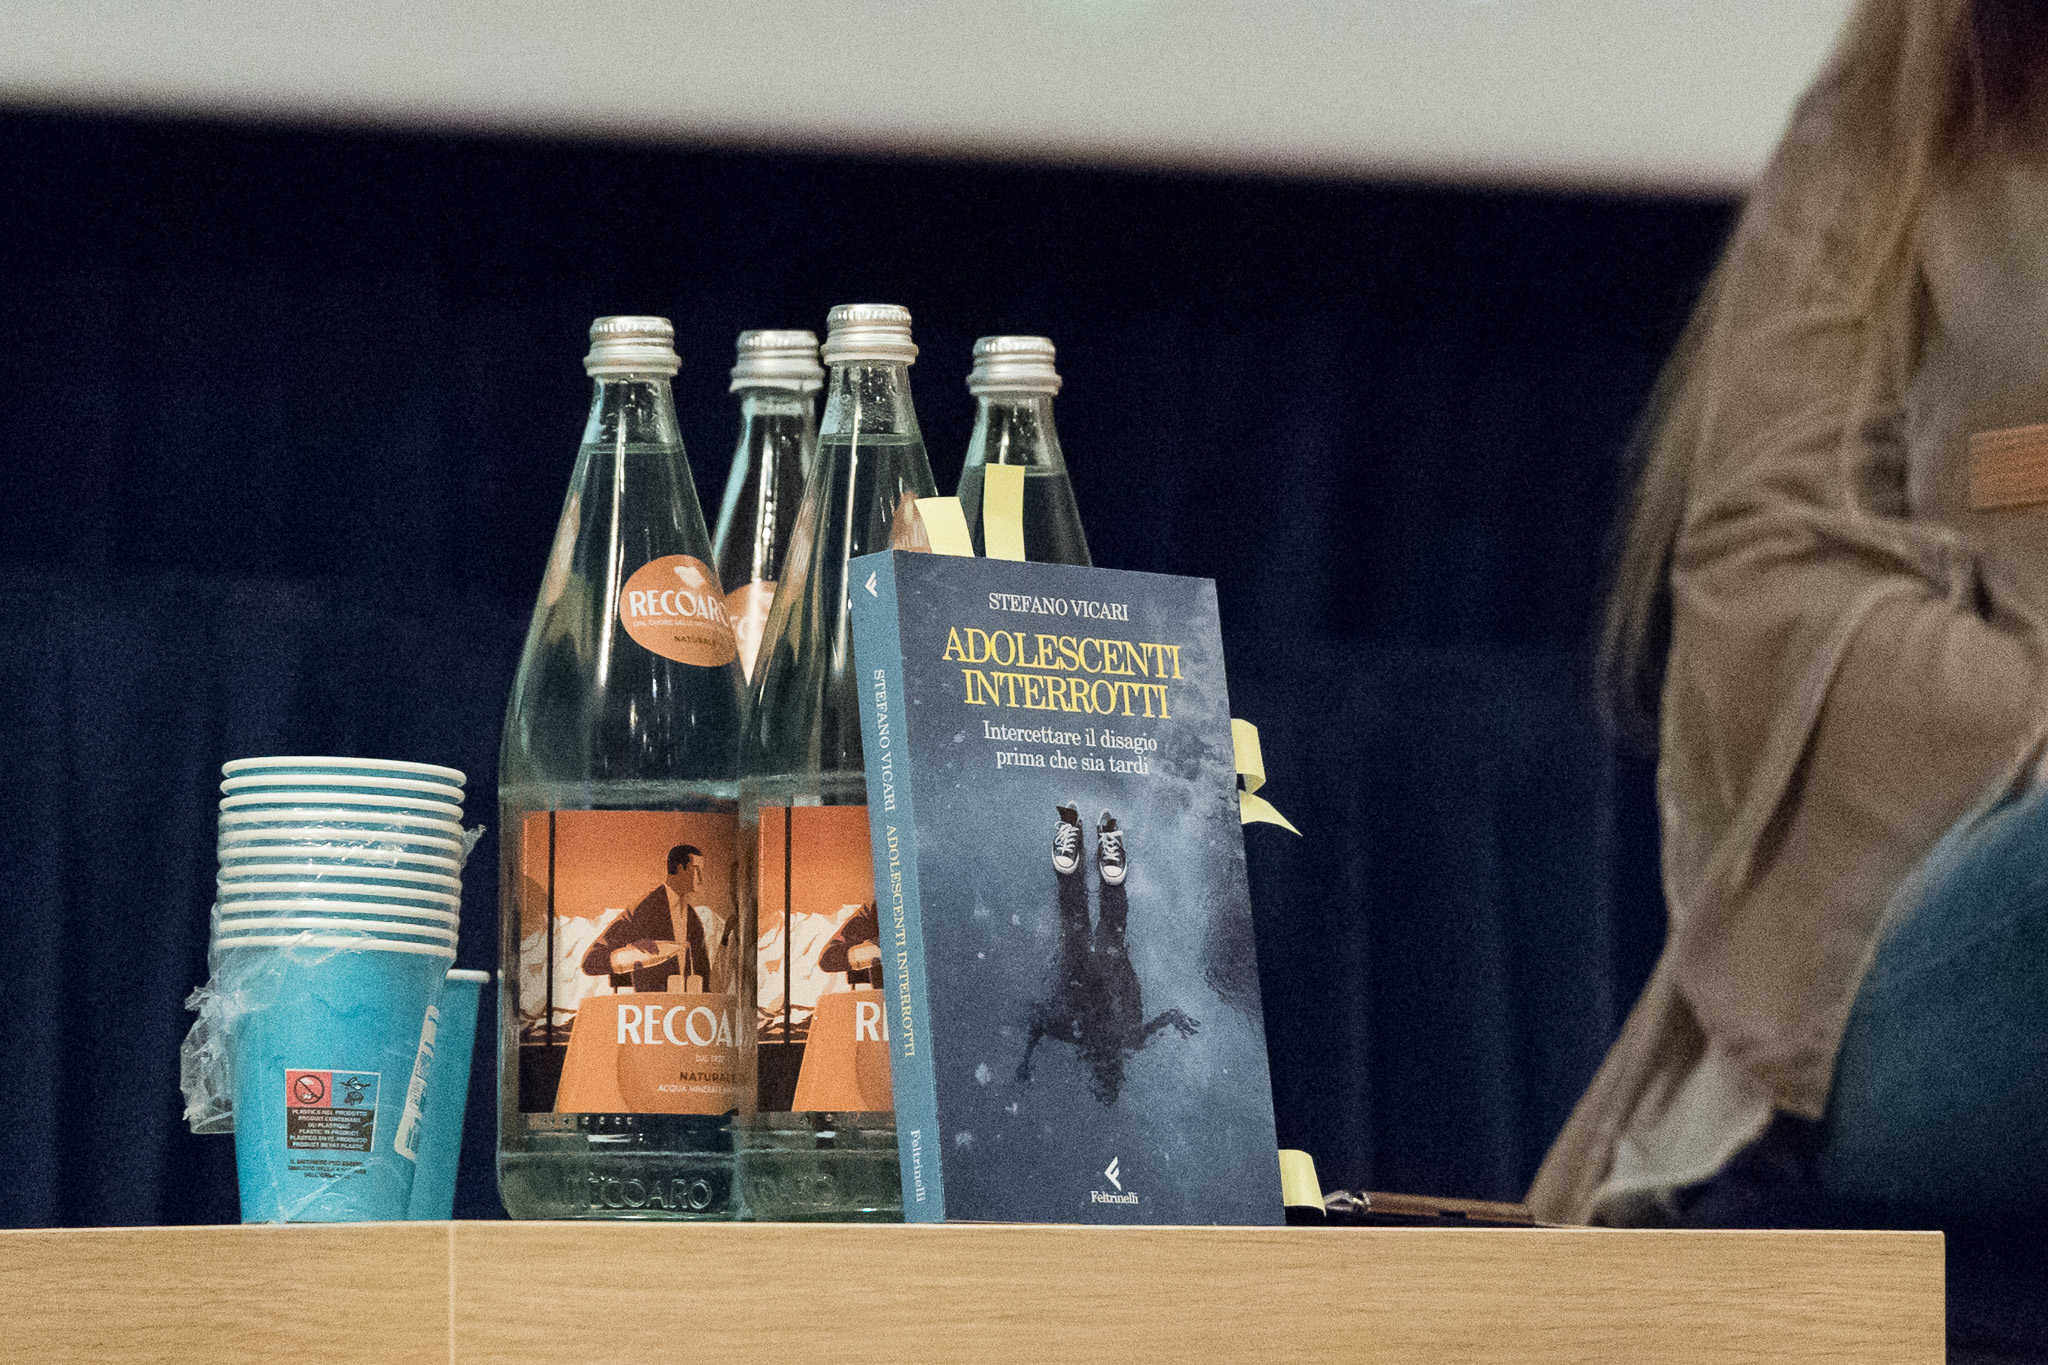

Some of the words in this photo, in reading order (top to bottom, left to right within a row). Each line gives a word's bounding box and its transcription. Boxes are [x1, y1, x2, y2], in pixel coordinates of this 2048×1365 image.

[629, 590, 730, 627] RECOARO
[989, 592, 1068, 616] STEFANO
[1070, 600, 1129, 621] VICARI
[942, 626, 1184, 680] ADOLESCENTI
[873, 669, 890, 749] STEFANO
[961, 668, 1172, 719] INTERROTTI
[982, 720, 1081, 748] Intercettare
[1085, 728, 1096, 748] il
[1100, 729, 1158, 755] disagio
[996, 747, 1045, 769] prima
[1049, 750, 1077, 770] che
[1081, 754, 1105, 772] sia
[1108, 756, 1149, 775] tardi
[881, 751, 896, 812] VICARI
[886, 824, 906, 946] ADOLESCENTI
[897, 950, 916, 1058] INTERROTTI
[657, 1084, 687, 1093] ACQUA
[910, 1129, 926, 1202] Feltrinelli
[1090, 1190, 1139, 1205] Feltrinelli
